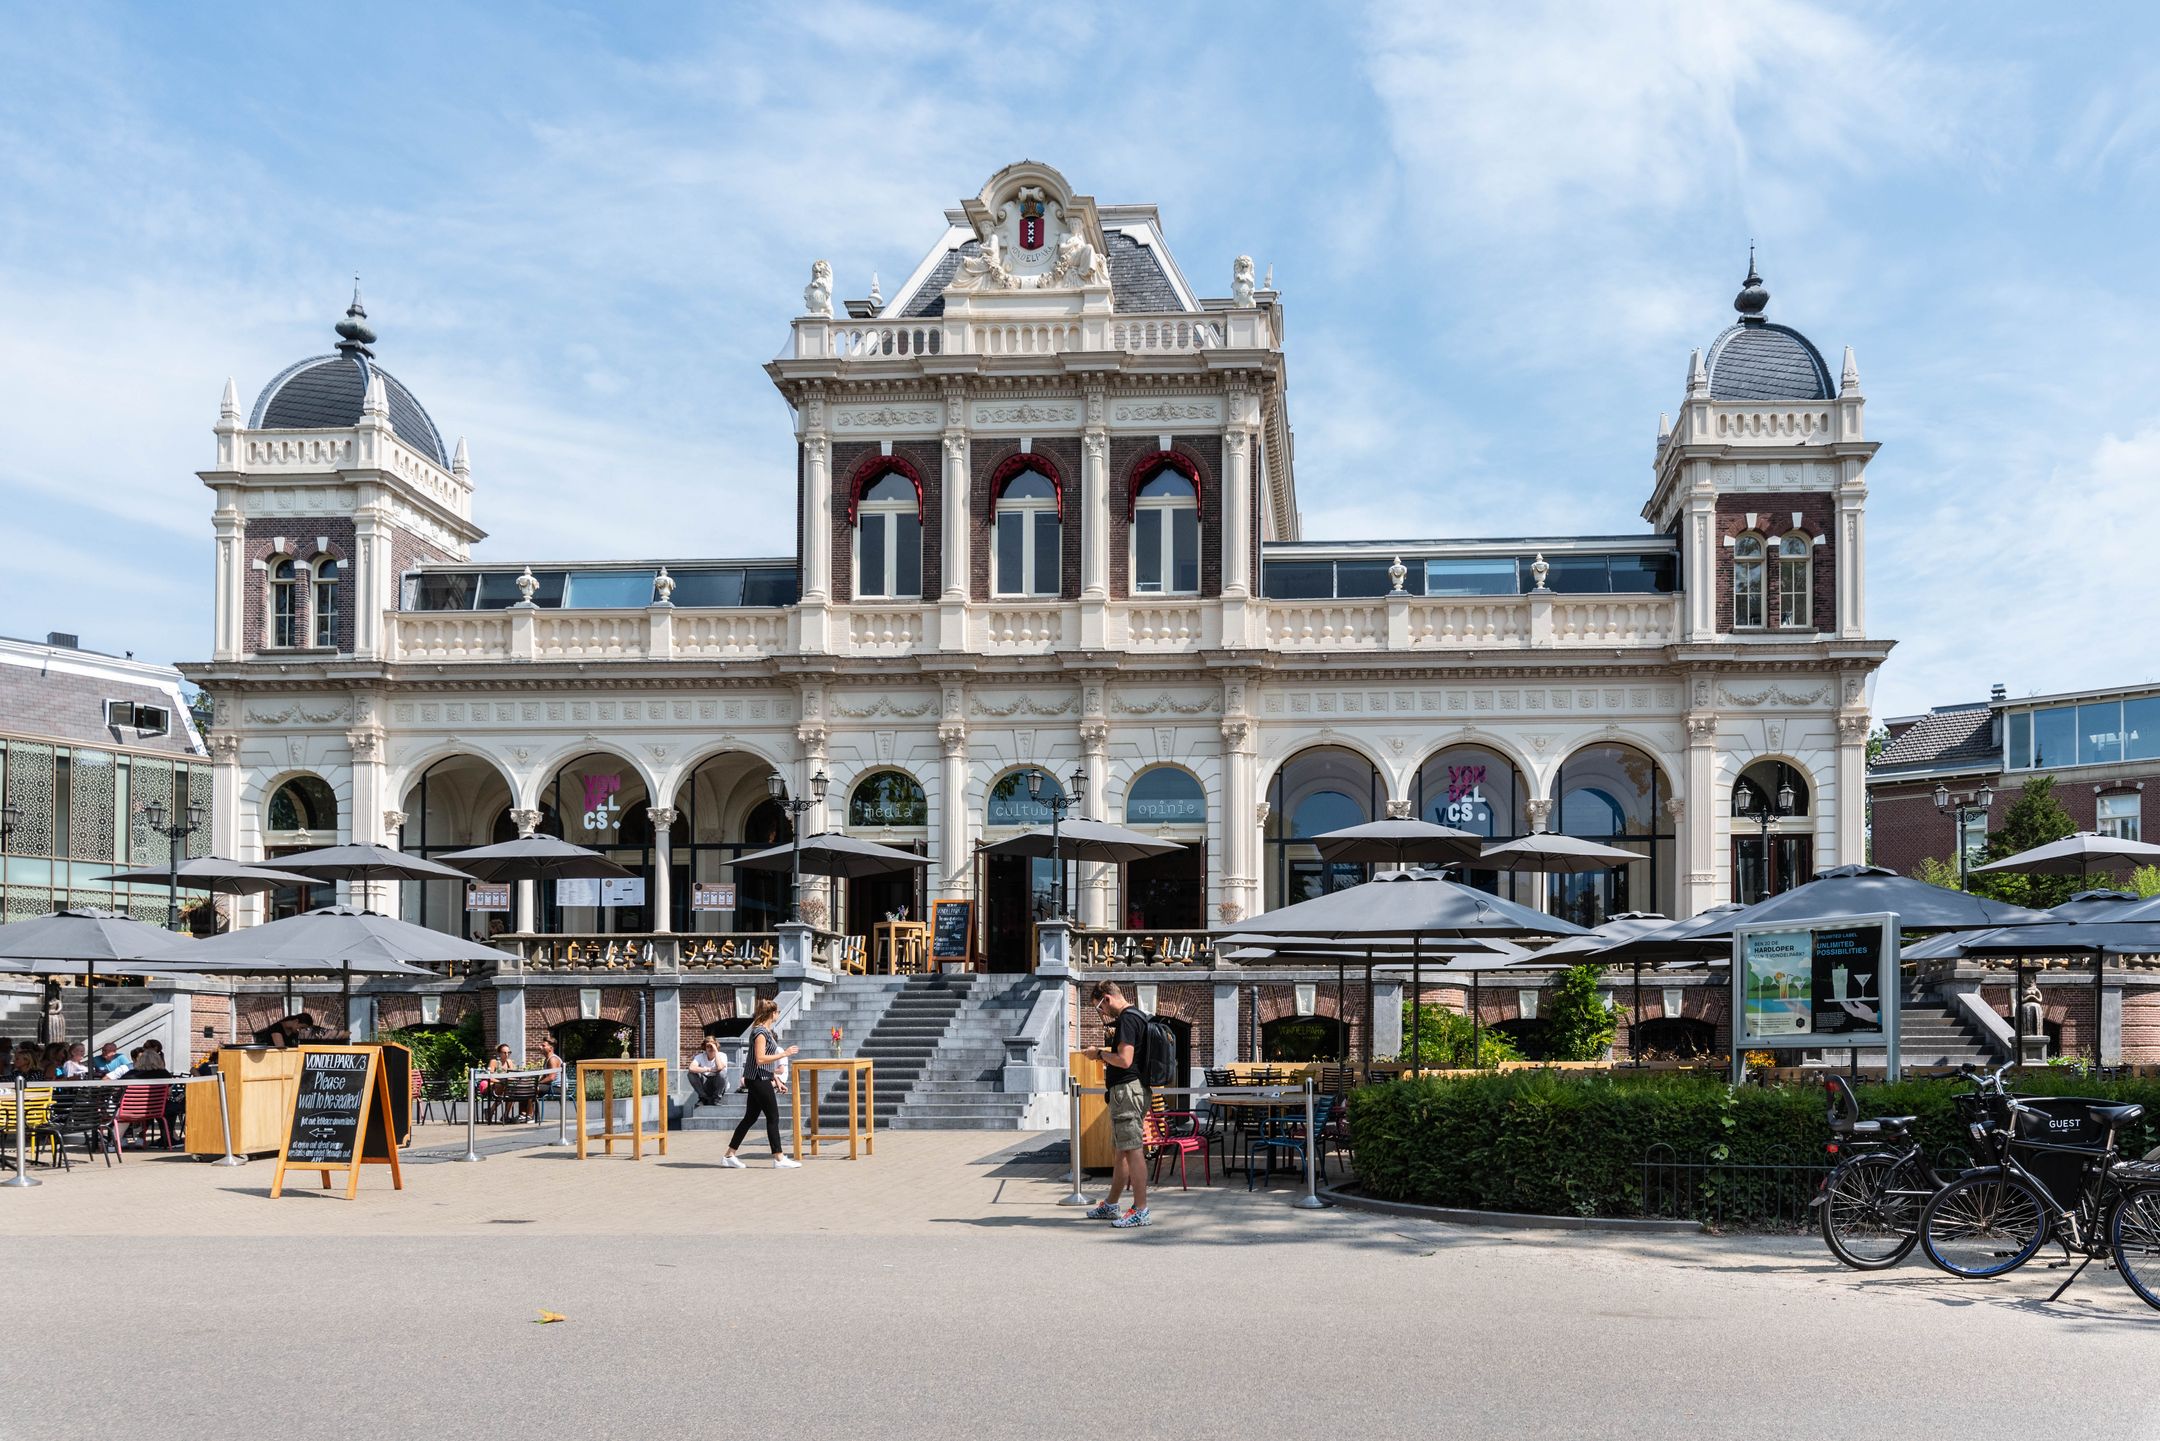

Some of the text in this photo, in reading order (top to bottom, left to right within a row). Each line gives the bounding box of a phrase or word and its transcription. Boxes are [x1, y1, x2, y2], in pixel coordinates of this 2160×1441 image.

[1448, 765, 1486, 784] VON
[864, 803, 913, 818] media
[995, 804, 1056, 817] cultuu
[1138, 799, 1195, 818] opinie
[1754, 945, 1795, 954] HARDLOPER
[1816, 940, 1854, 949] UNLIMITED
[1816, 947, 1867, 956] POSSIBILITIES
[314, 1071, 346, 1090] Please
[298, 1089, 363, 1109] wait to be seated!
[2049, 1119, 2081, 1128] GUEST
